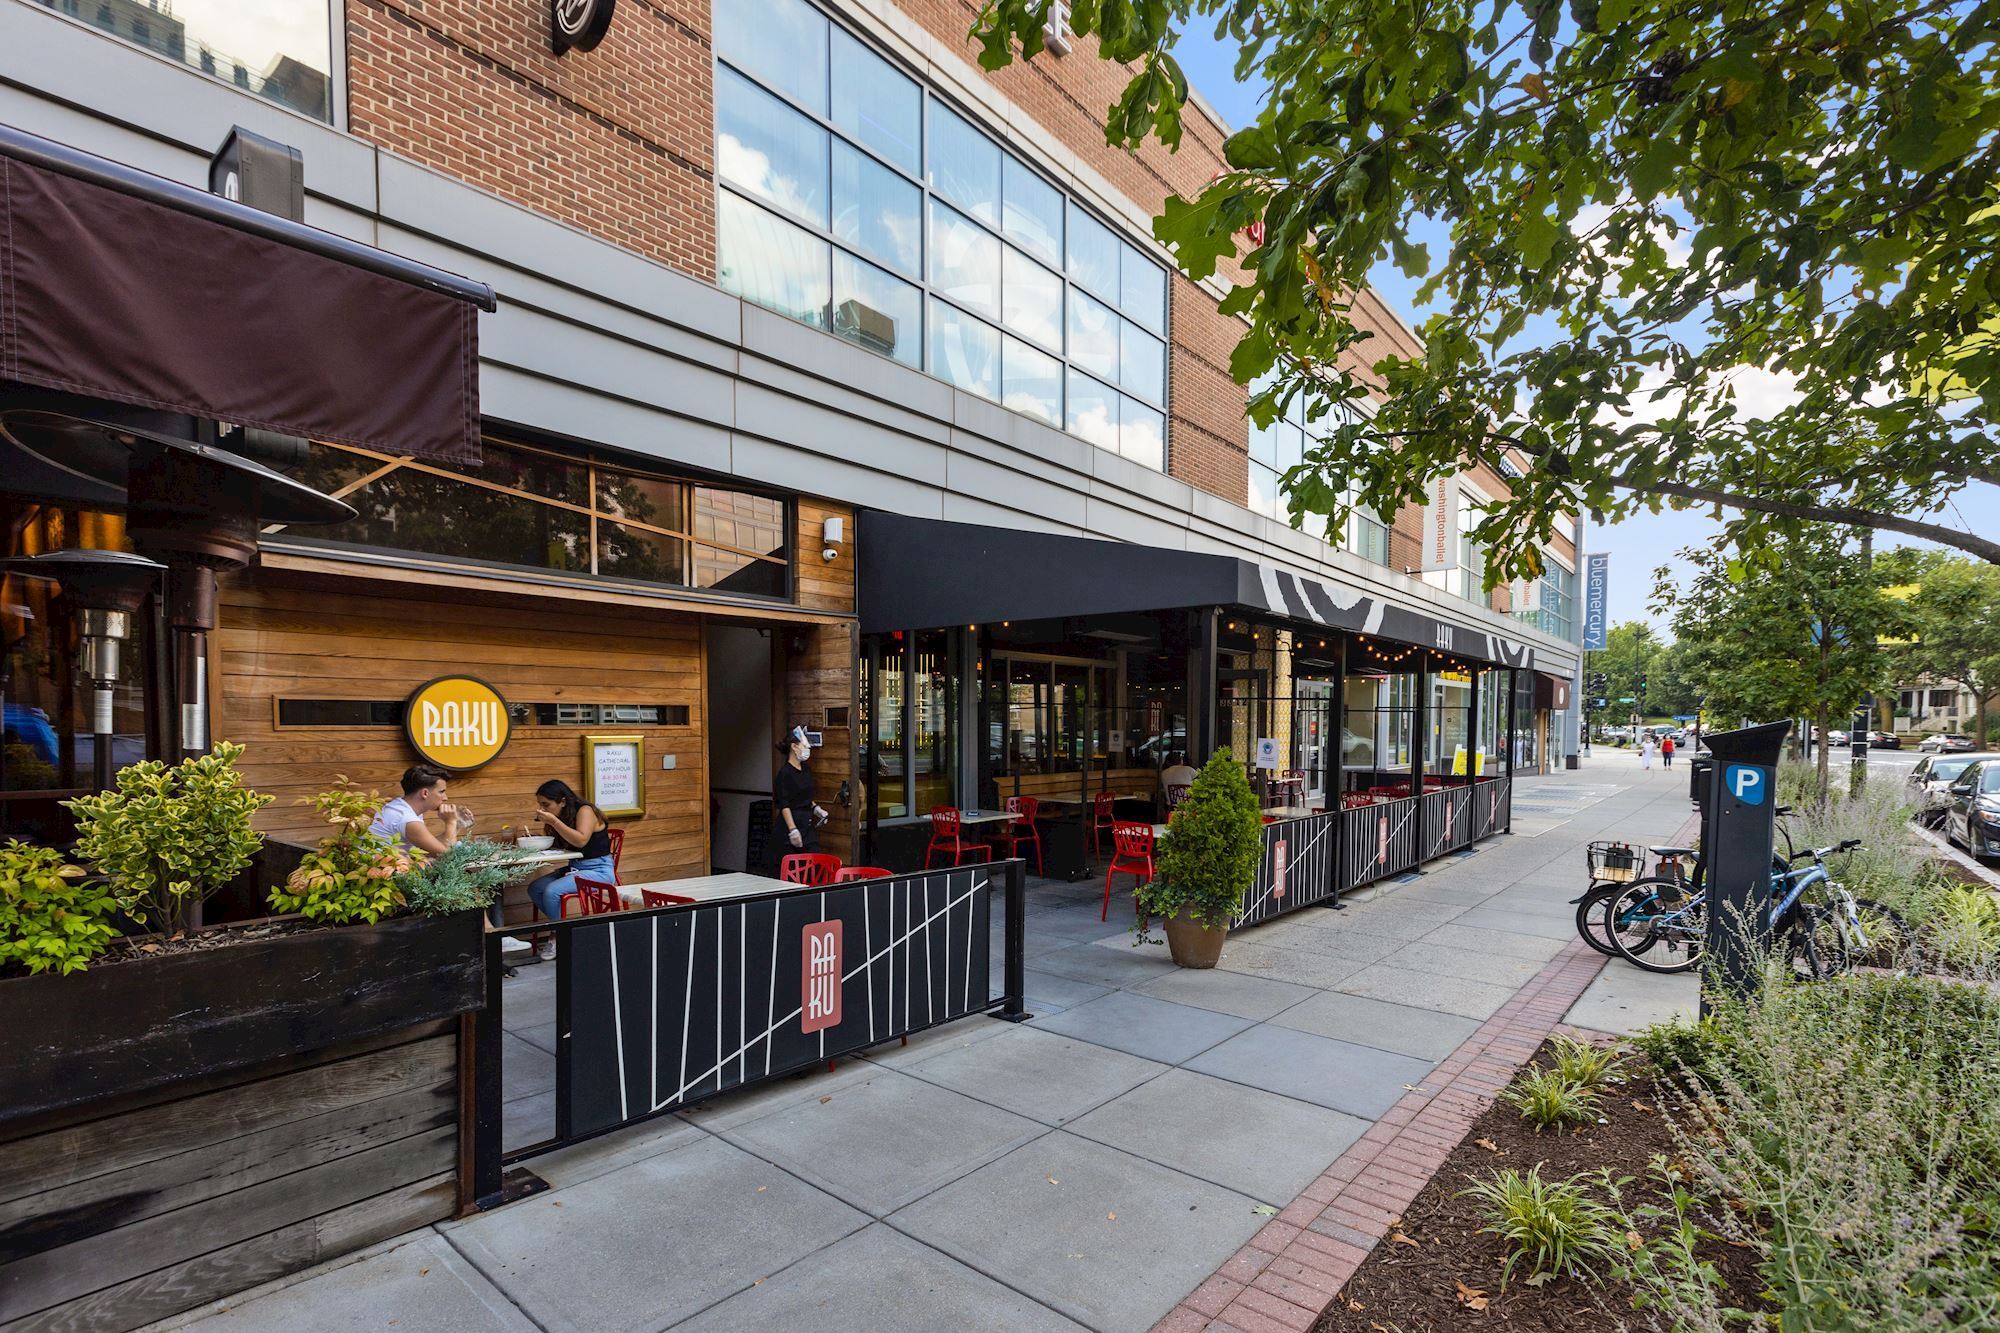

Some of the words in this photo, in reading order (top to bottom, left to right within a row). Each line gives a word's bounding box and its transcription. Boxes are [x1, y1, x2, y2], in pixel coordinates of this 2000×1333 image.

[1585, 557, 1608, 646] bluemercury
[422, 700, 498, 747] RAKU
[1736, 769, 1760, 797] P
